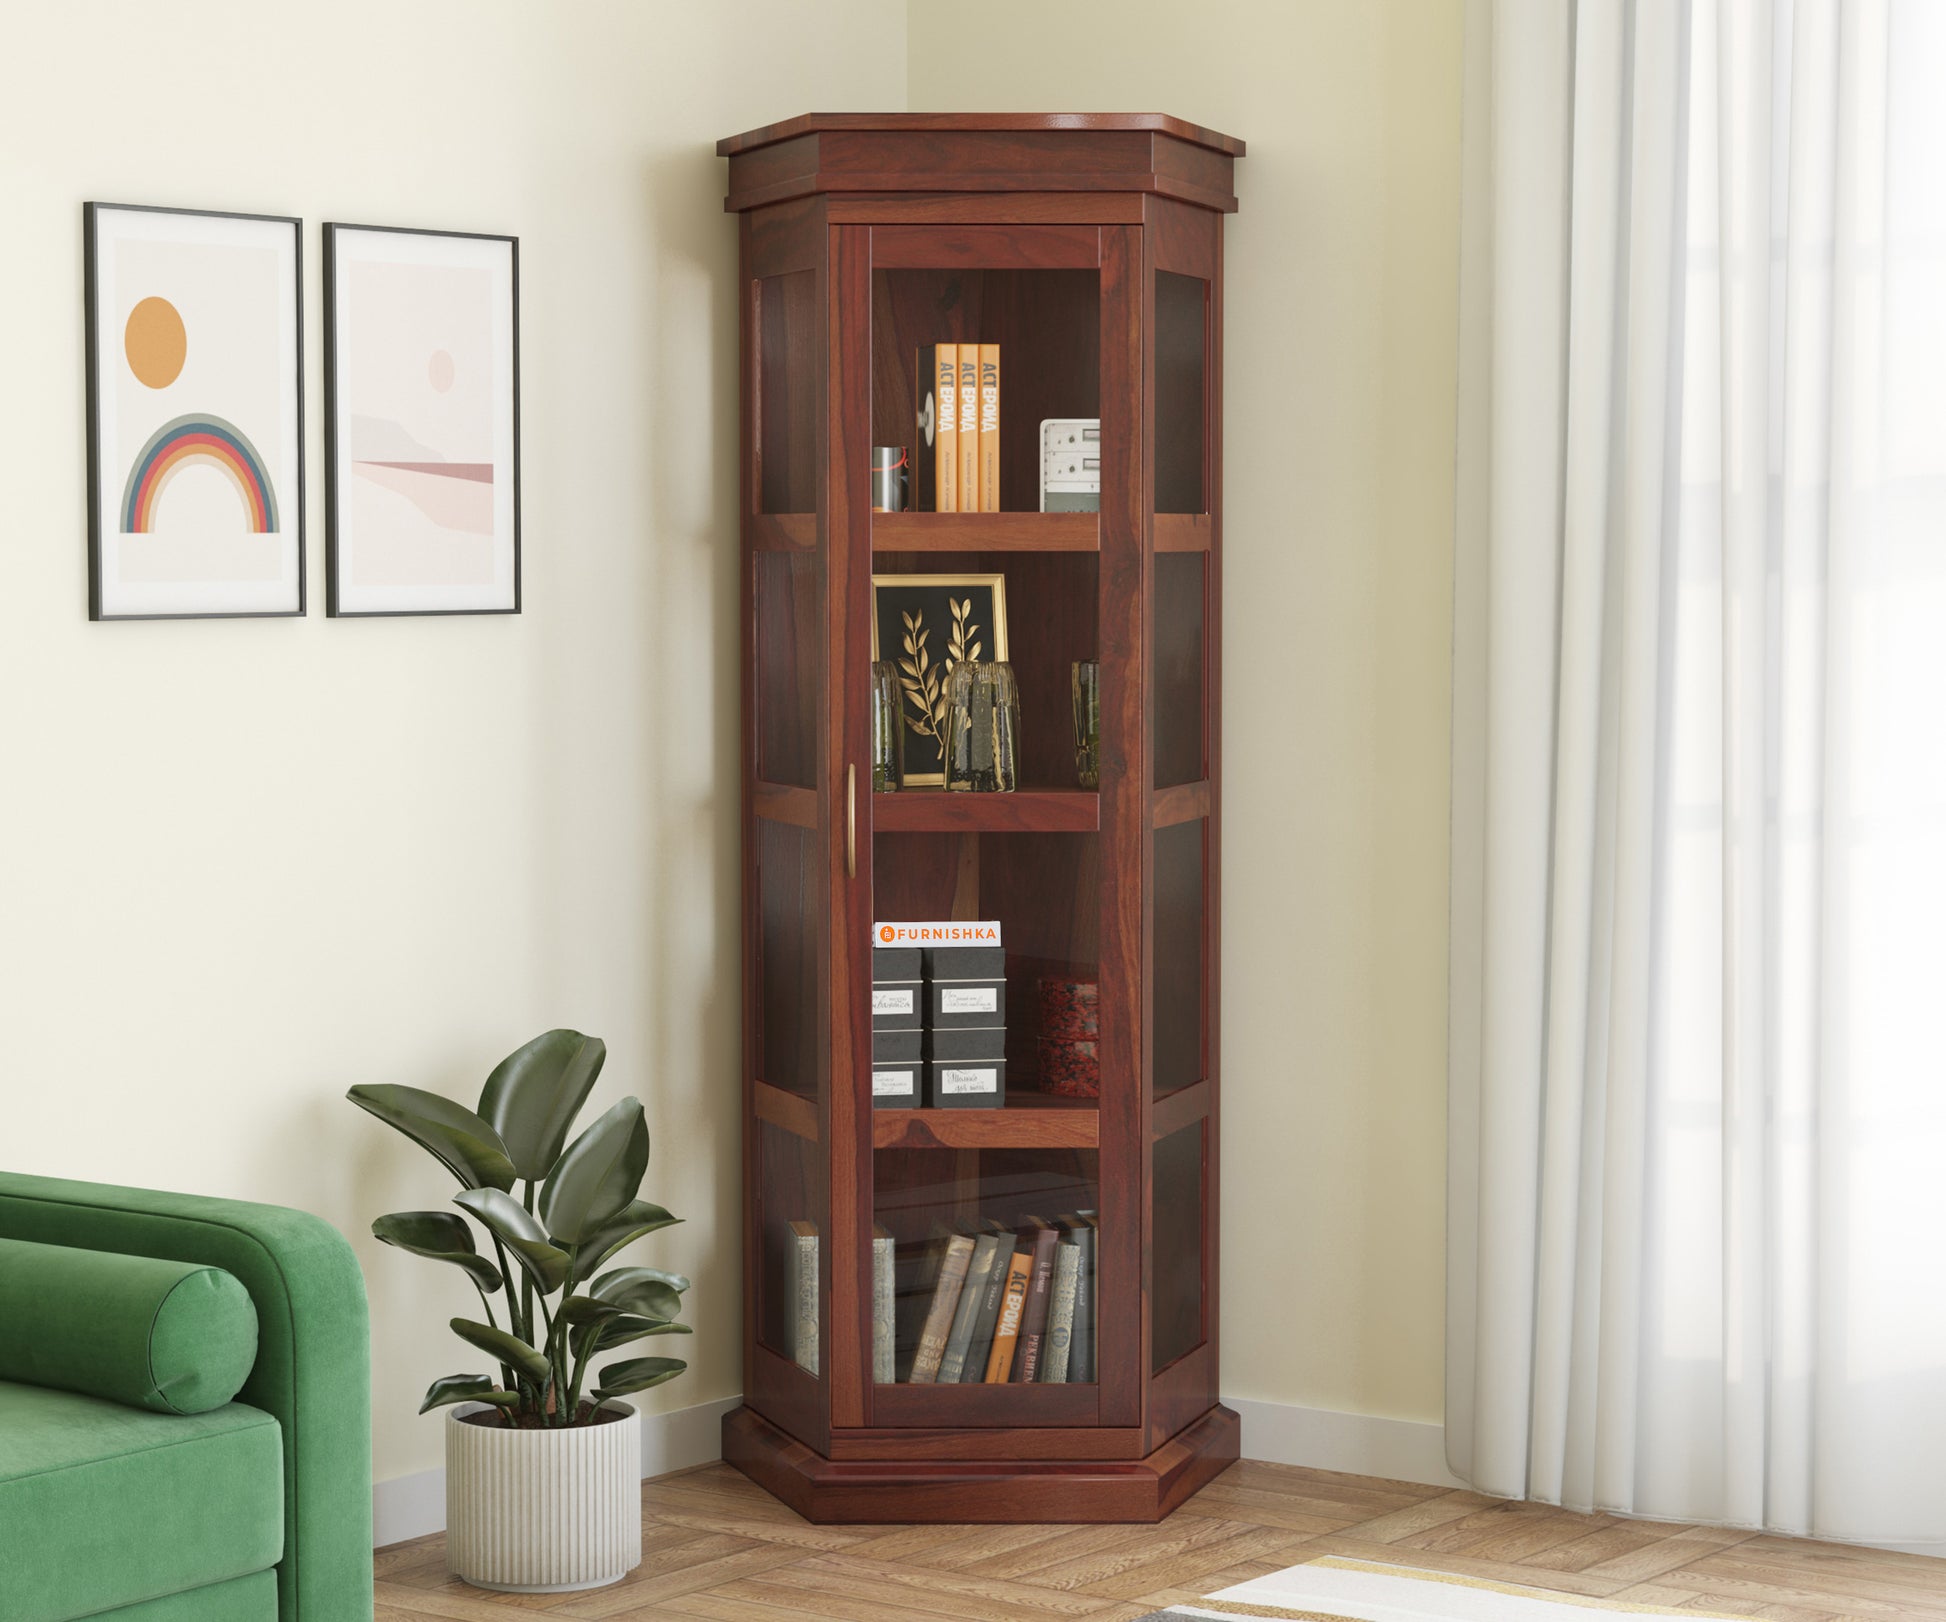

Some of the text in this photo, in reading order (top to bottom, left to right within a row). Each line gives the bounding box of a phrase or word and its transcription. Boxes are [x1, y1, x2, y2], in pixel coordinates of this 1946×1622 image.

[939, 362, 954, 432] АСТЕРОИД
[960, 362, 976, 432] АСТЕРОИД
[981, 362, 997, 432] АСТЕРОИД
[897, 928, 997, 940] FURNISHKA
[998, 1270, 1028, 1337] АСТЕРОИД
